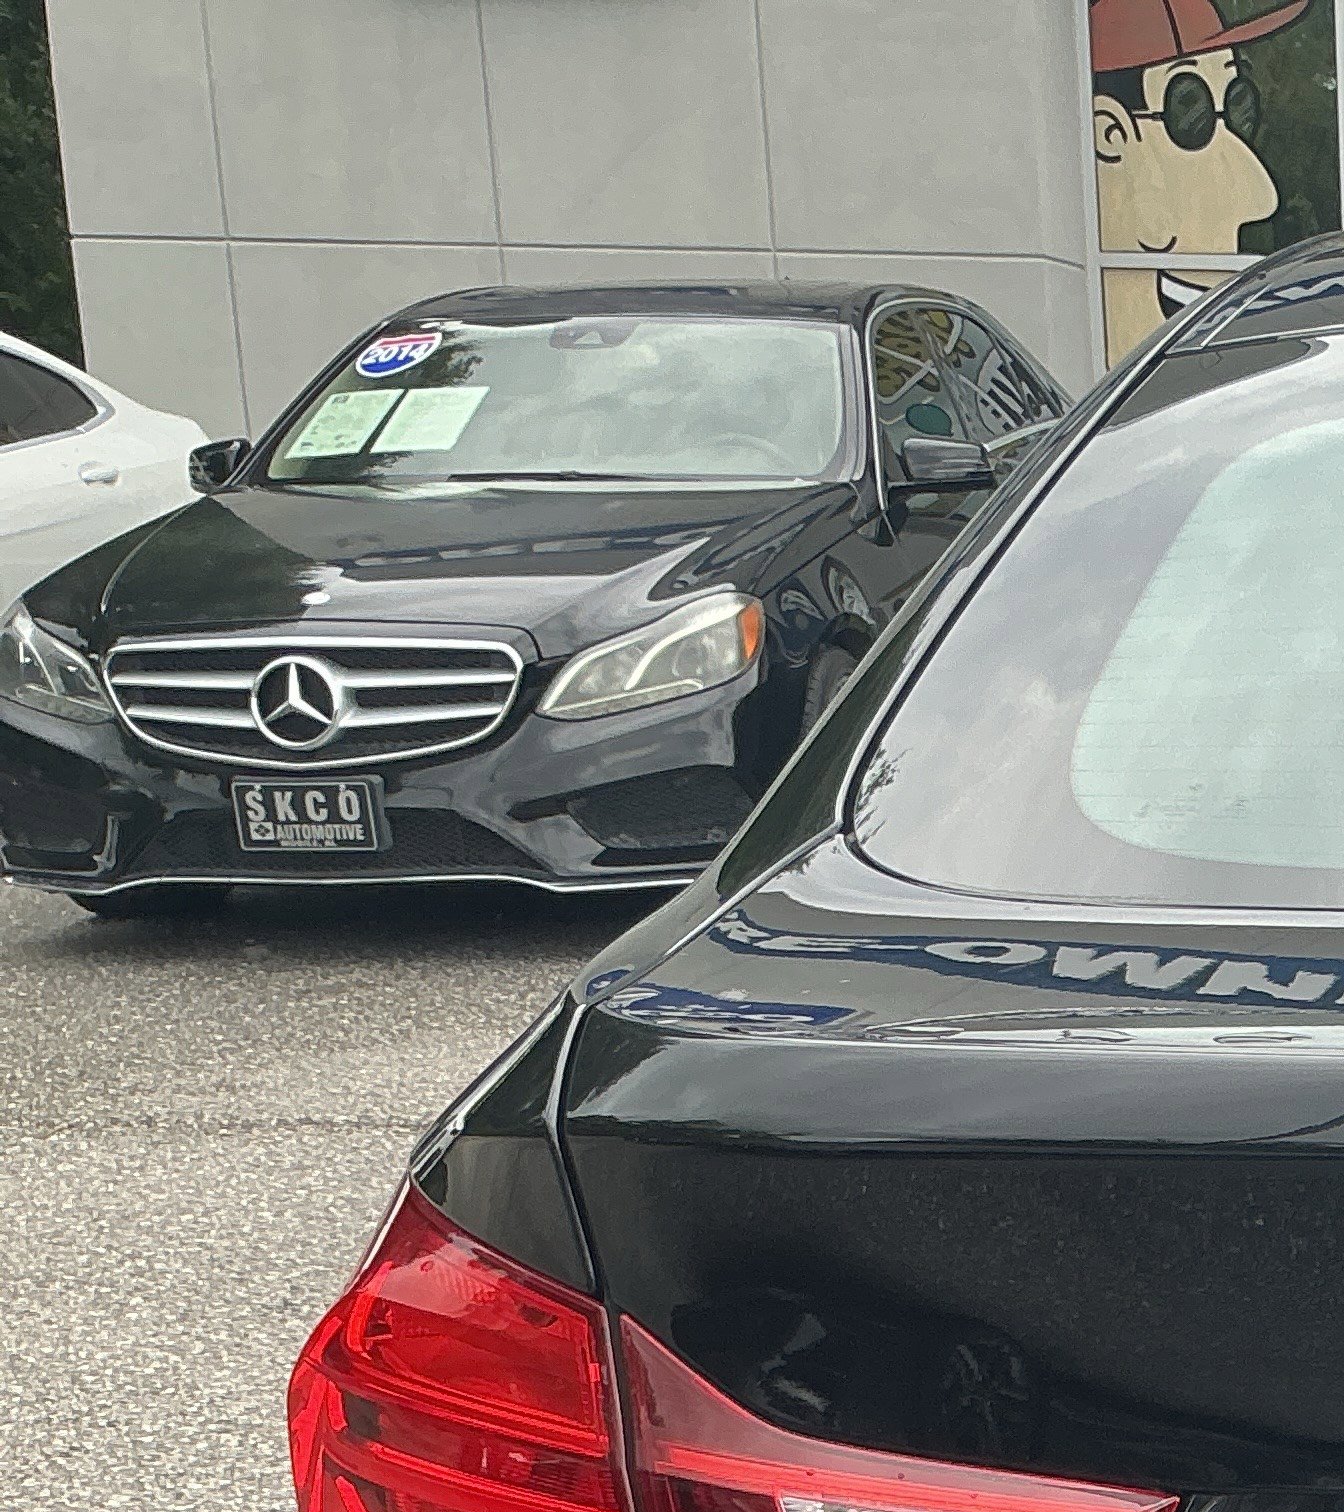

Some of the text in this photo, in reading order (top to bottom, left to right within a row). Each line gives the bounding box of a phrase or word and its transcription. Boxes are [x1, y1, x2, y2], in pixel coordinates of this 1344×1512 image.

[361, 343, 433, 365] 2014
[244, 789, 361, 823] SKCO
[275, 823, 366, 842] AUTOMOTIVE
